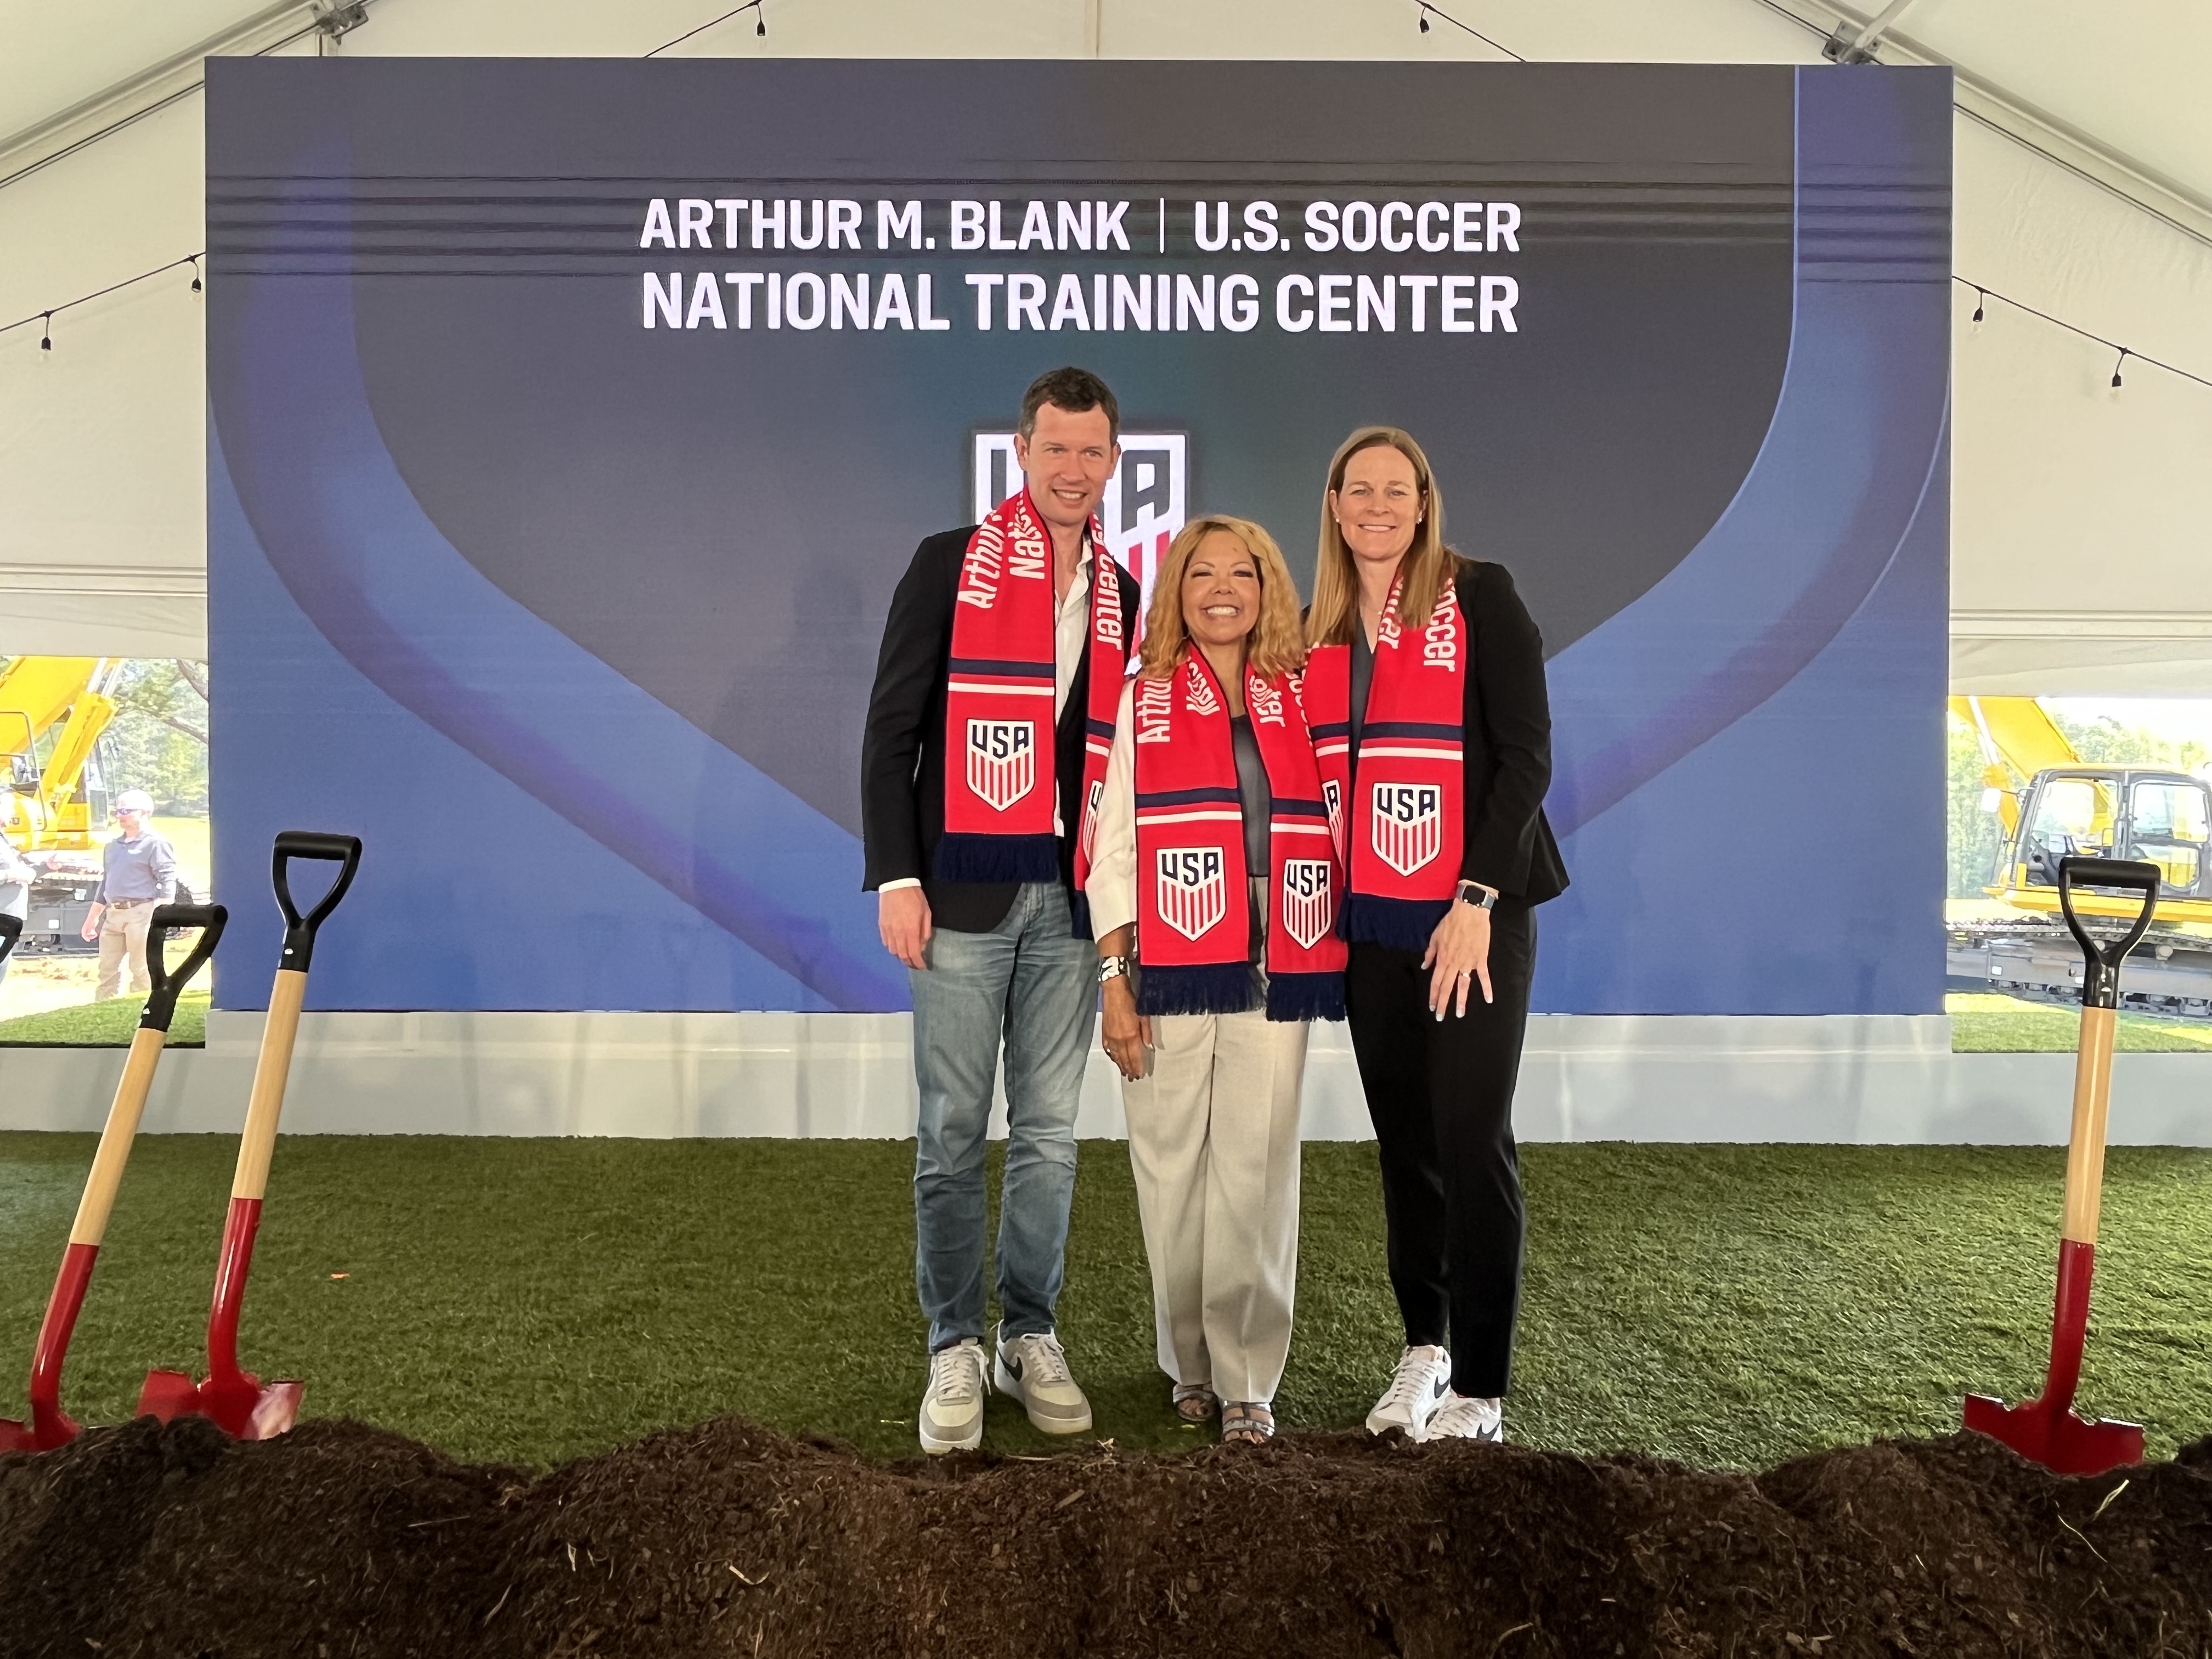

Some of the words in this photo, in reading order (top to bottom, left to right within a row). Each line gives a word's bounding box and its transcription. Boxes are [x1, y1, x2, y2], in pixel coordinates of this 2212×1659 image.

[640, 199, 863, 249] ARTHUR
[877, 200, 935, 250] M.
[951, 200, 1130, 251] BLANK
[1195, 201, 1290, 252] U.S.
[1304, 201, 1521, 252] SOCCER
[642, 272, 950, 330] NATIONAL
[965, 274, 1259, 332] TRAINING
[1276, 274, 1520, 332] CENTER
[1136, 678, 1172, 744] Arthu
[972, 724, 1029, 759] USA
[1376, 788, 1435, 822] USA
[1161, 852, 1220, 887] USA
[1286, 864, 1328, 898] USA
